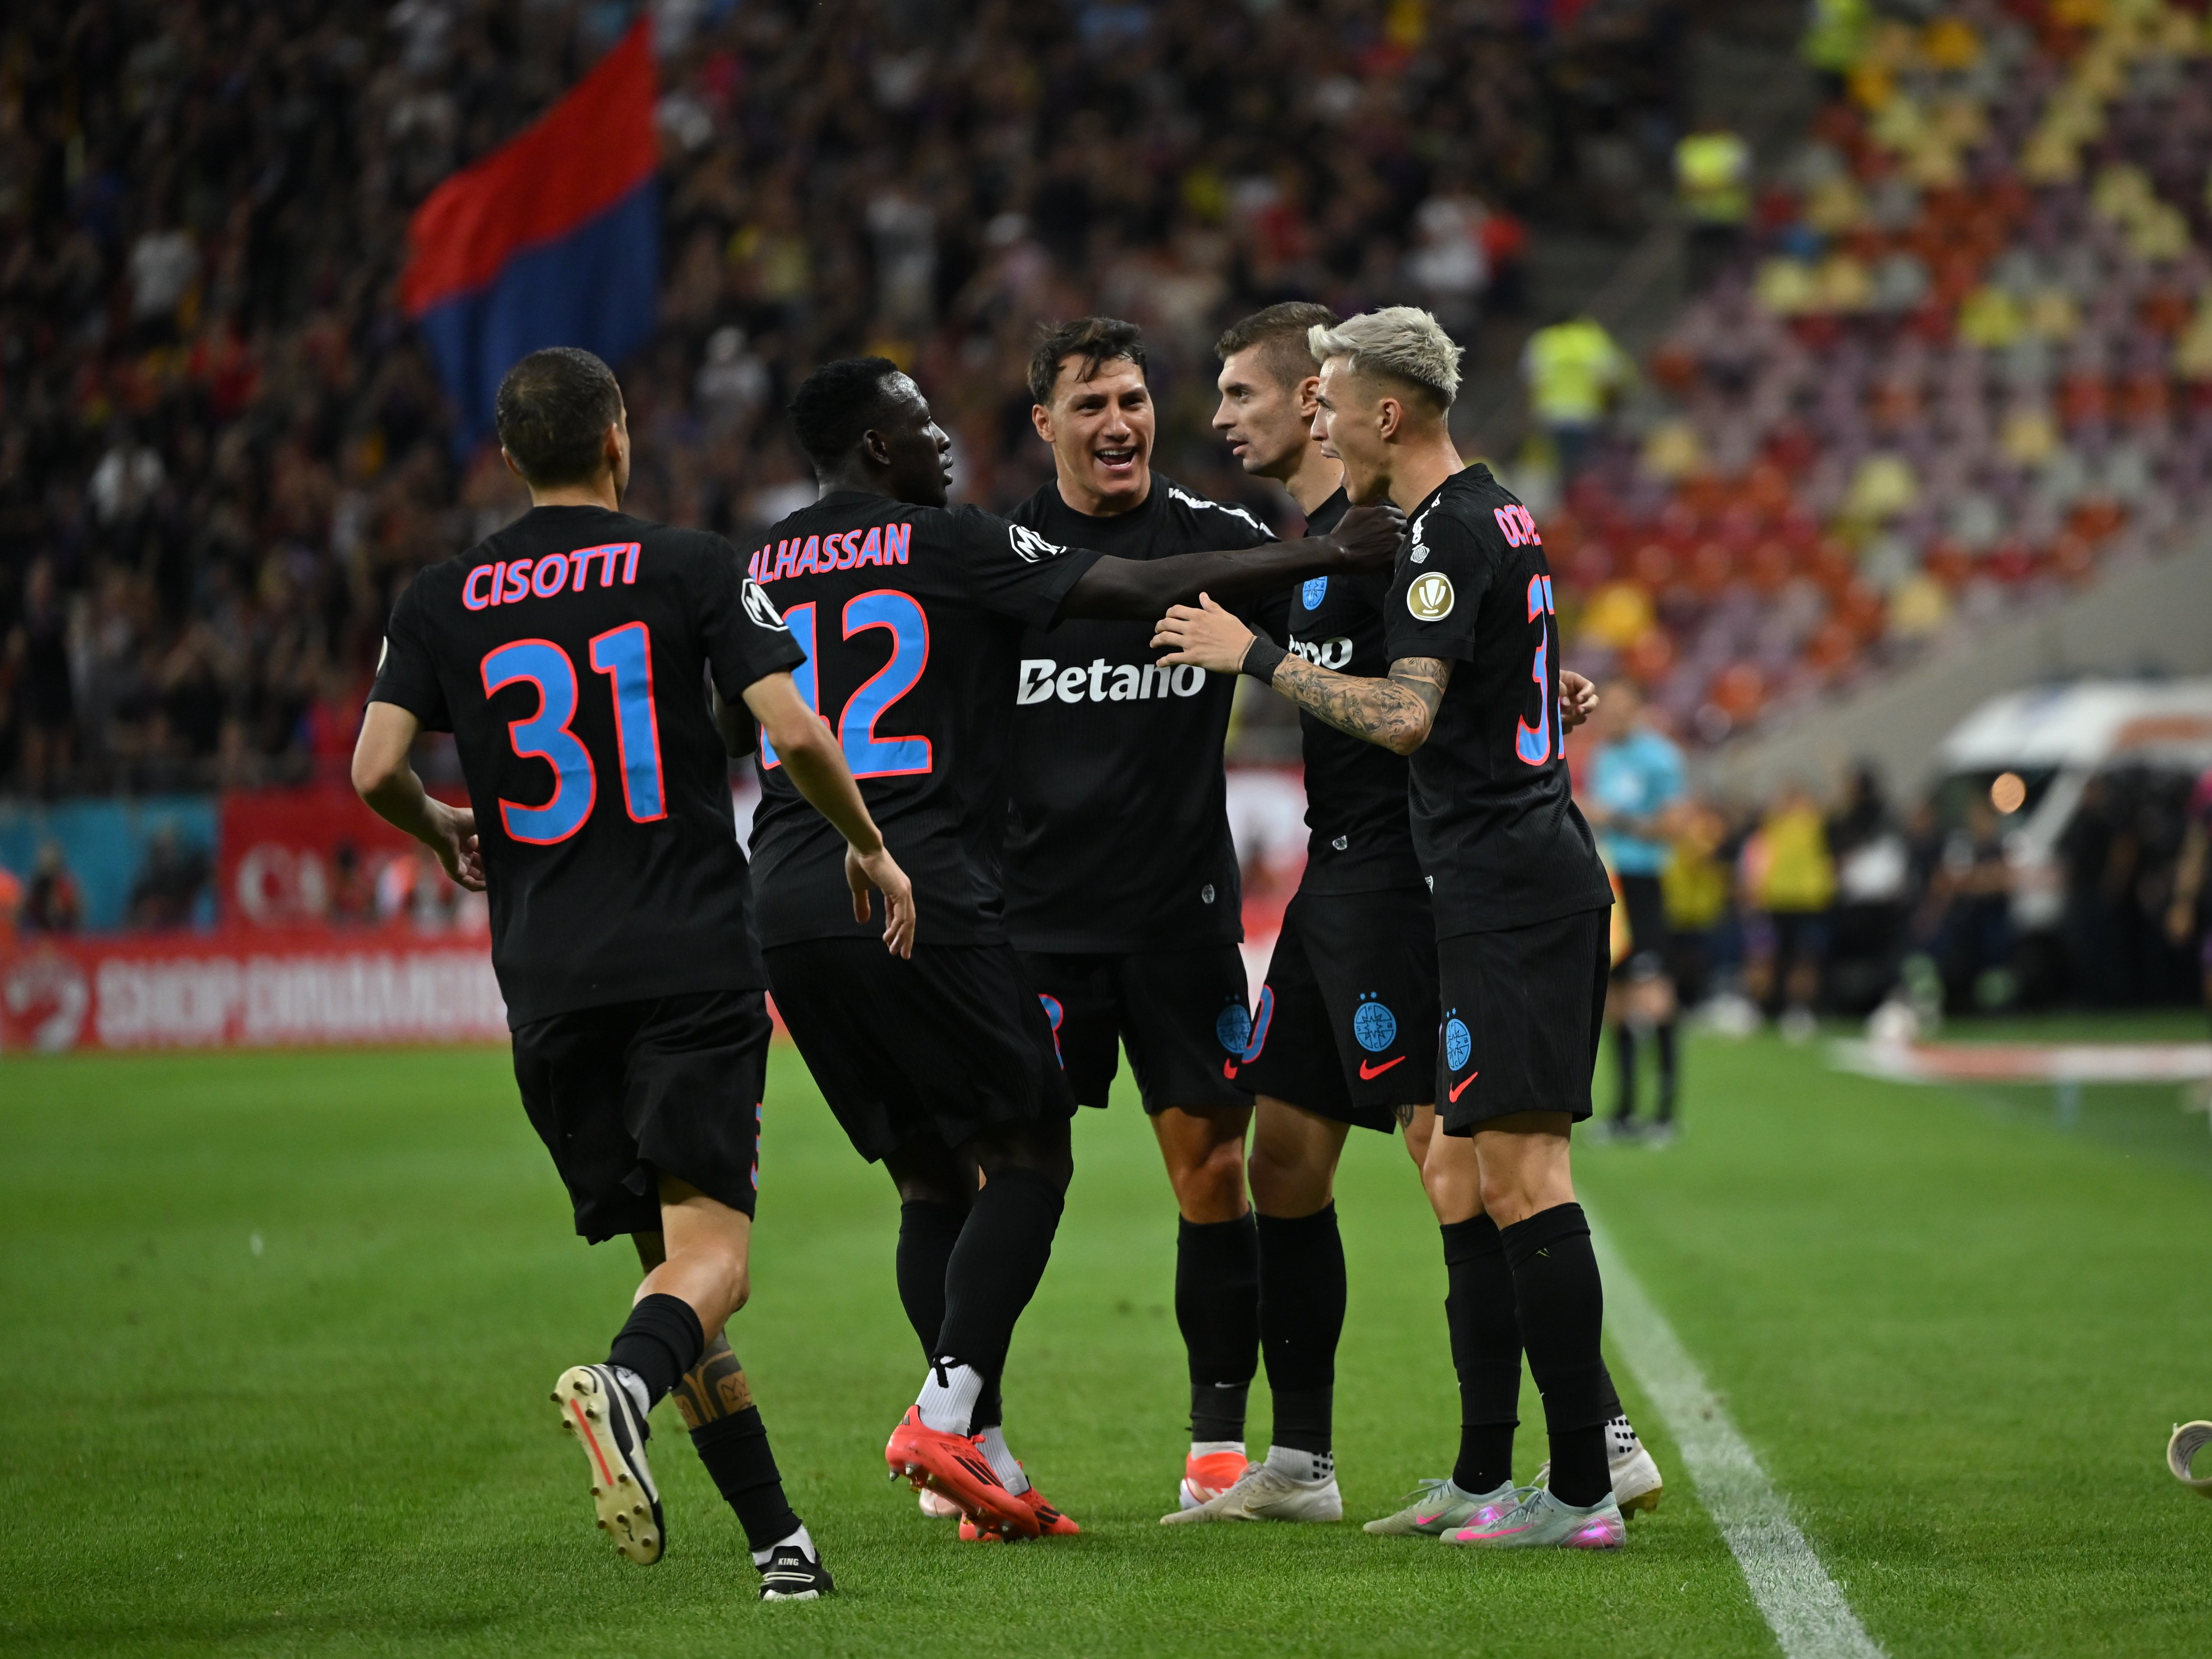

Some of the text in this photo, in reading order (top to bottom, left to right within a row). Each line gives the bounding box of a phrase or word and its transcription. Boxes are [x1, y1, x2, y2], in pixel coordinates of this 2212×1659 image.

[462, 542, 641, 610] CISOTTI
[748, 523, 911, 585] ALHASSAN
[1016, 658, 1206, 705] Betano
[480, 621, 668, 846] 31
